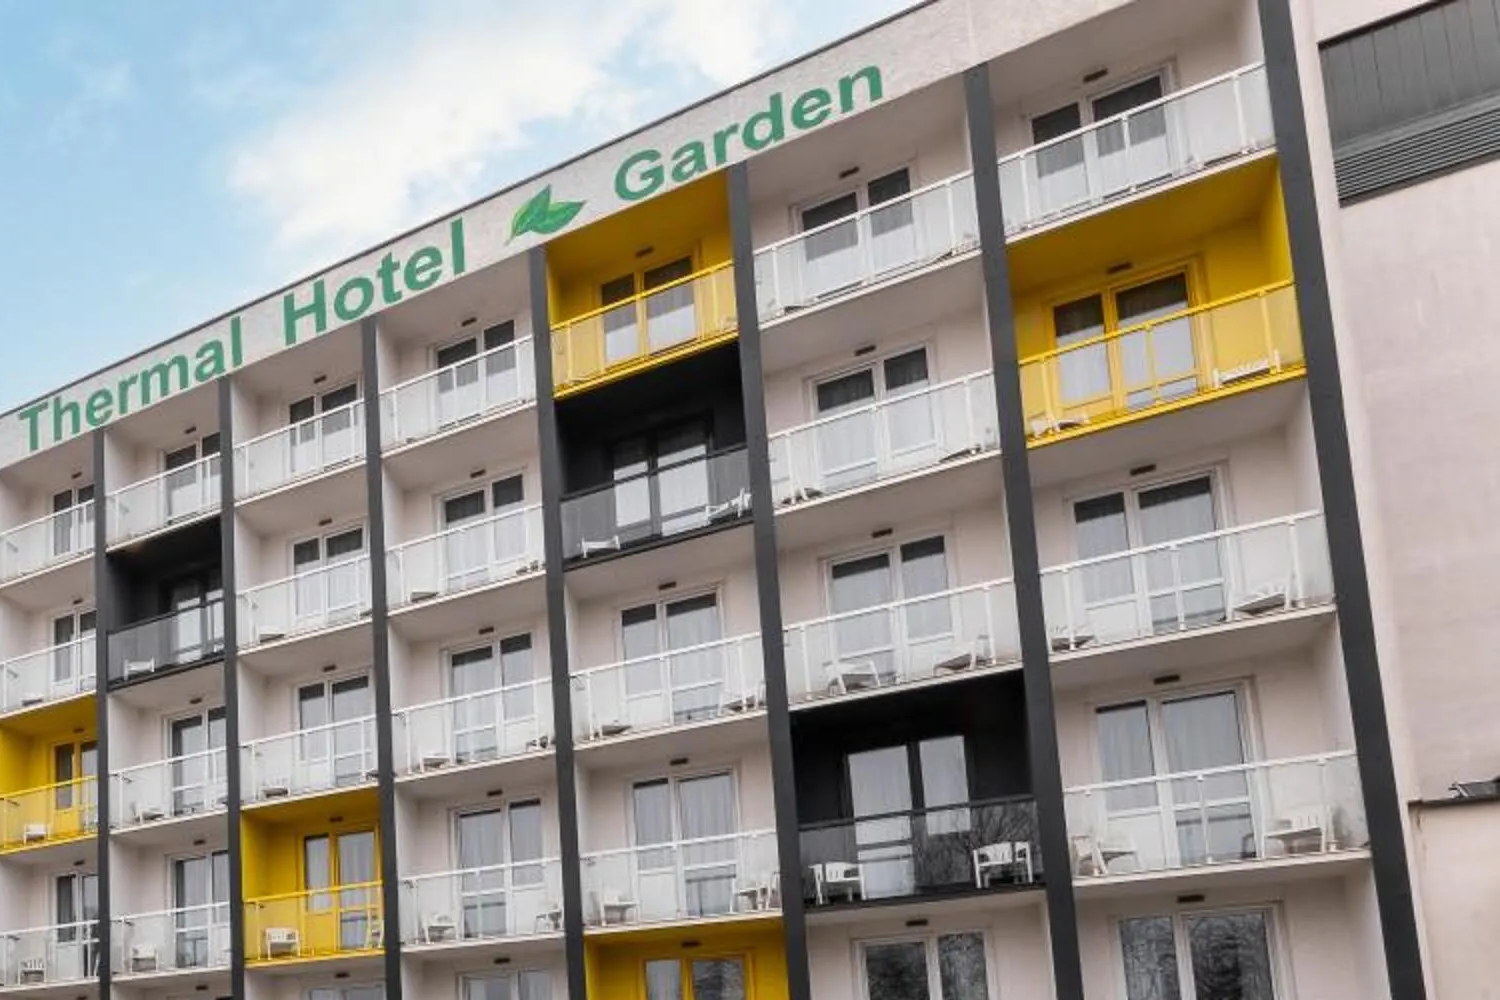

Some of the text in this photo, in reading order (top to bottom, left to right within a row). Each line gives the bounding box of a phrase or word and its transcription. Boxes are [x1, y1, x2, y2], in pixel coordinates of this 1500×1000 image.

[19, 65, 884, 452] Thermal Hotel Garden
